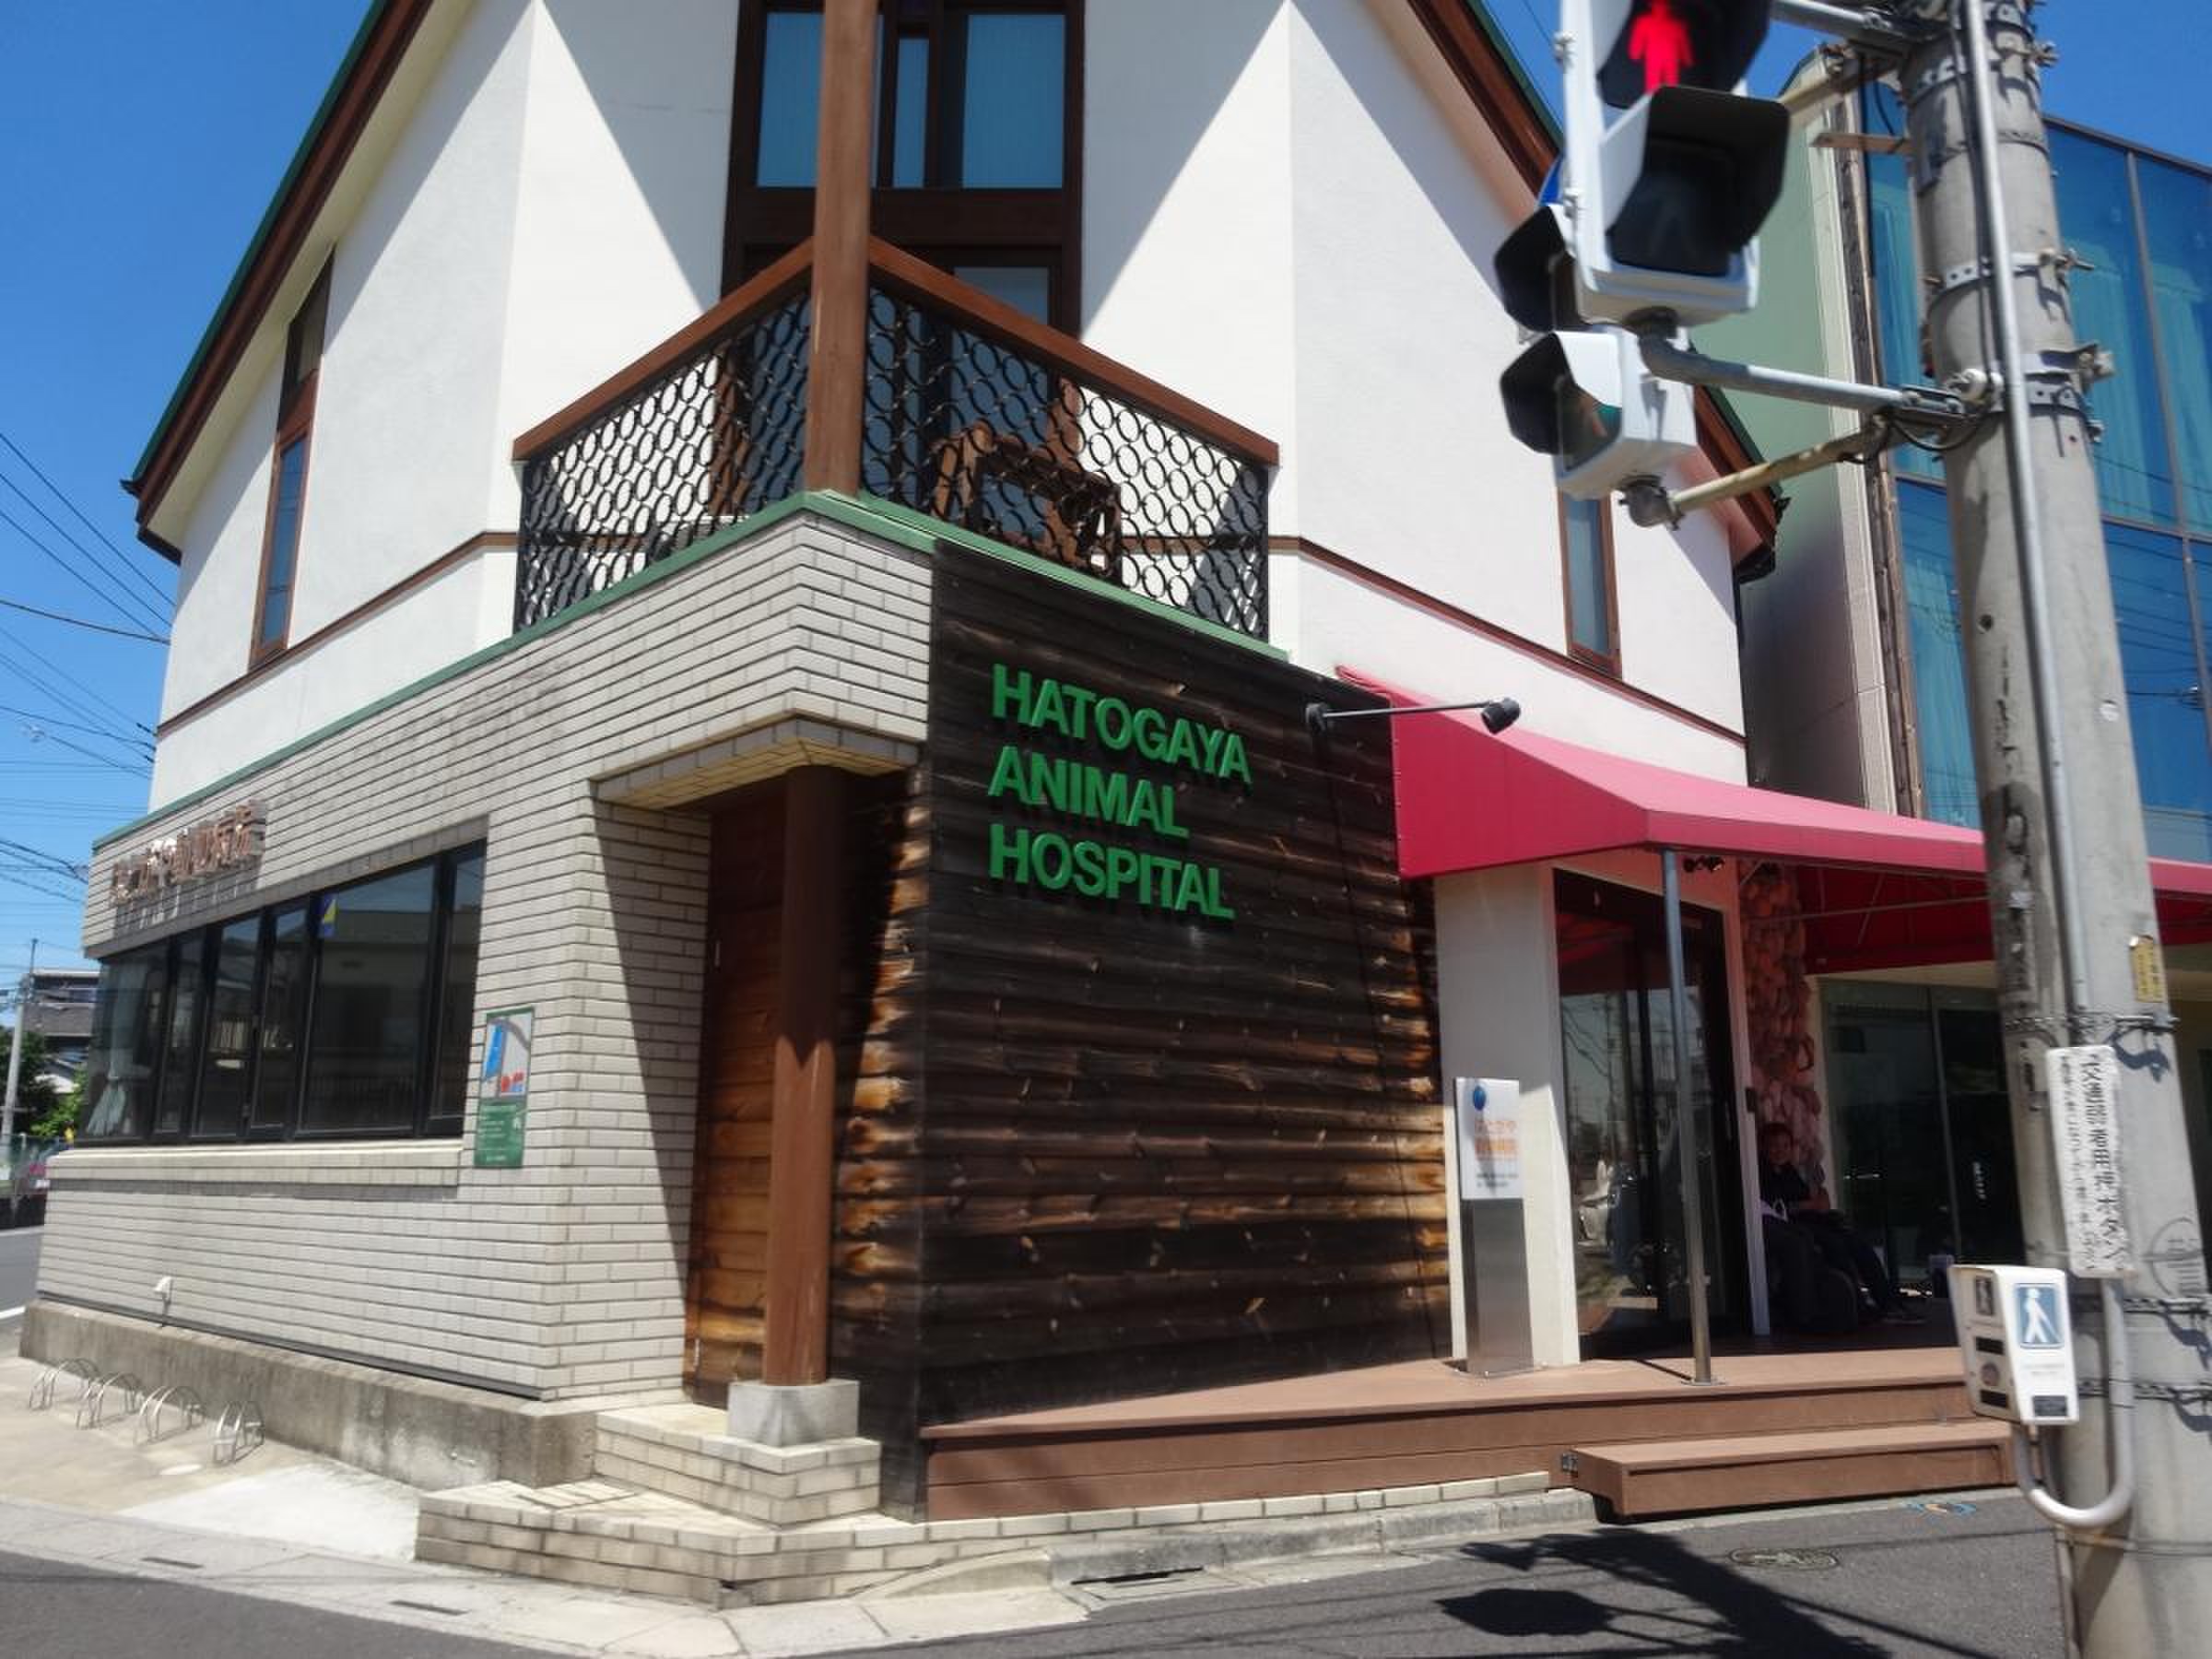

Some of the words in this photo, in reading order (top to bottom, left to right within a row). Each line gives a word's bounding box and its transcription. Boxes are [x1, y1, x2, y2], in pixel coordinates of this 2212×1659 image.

[993, 663, 1253, 784] HATOGAYA
[987, 746, 1190, 839] ANIMAL
[989, 824, 1236, 920] HOSPITAL
